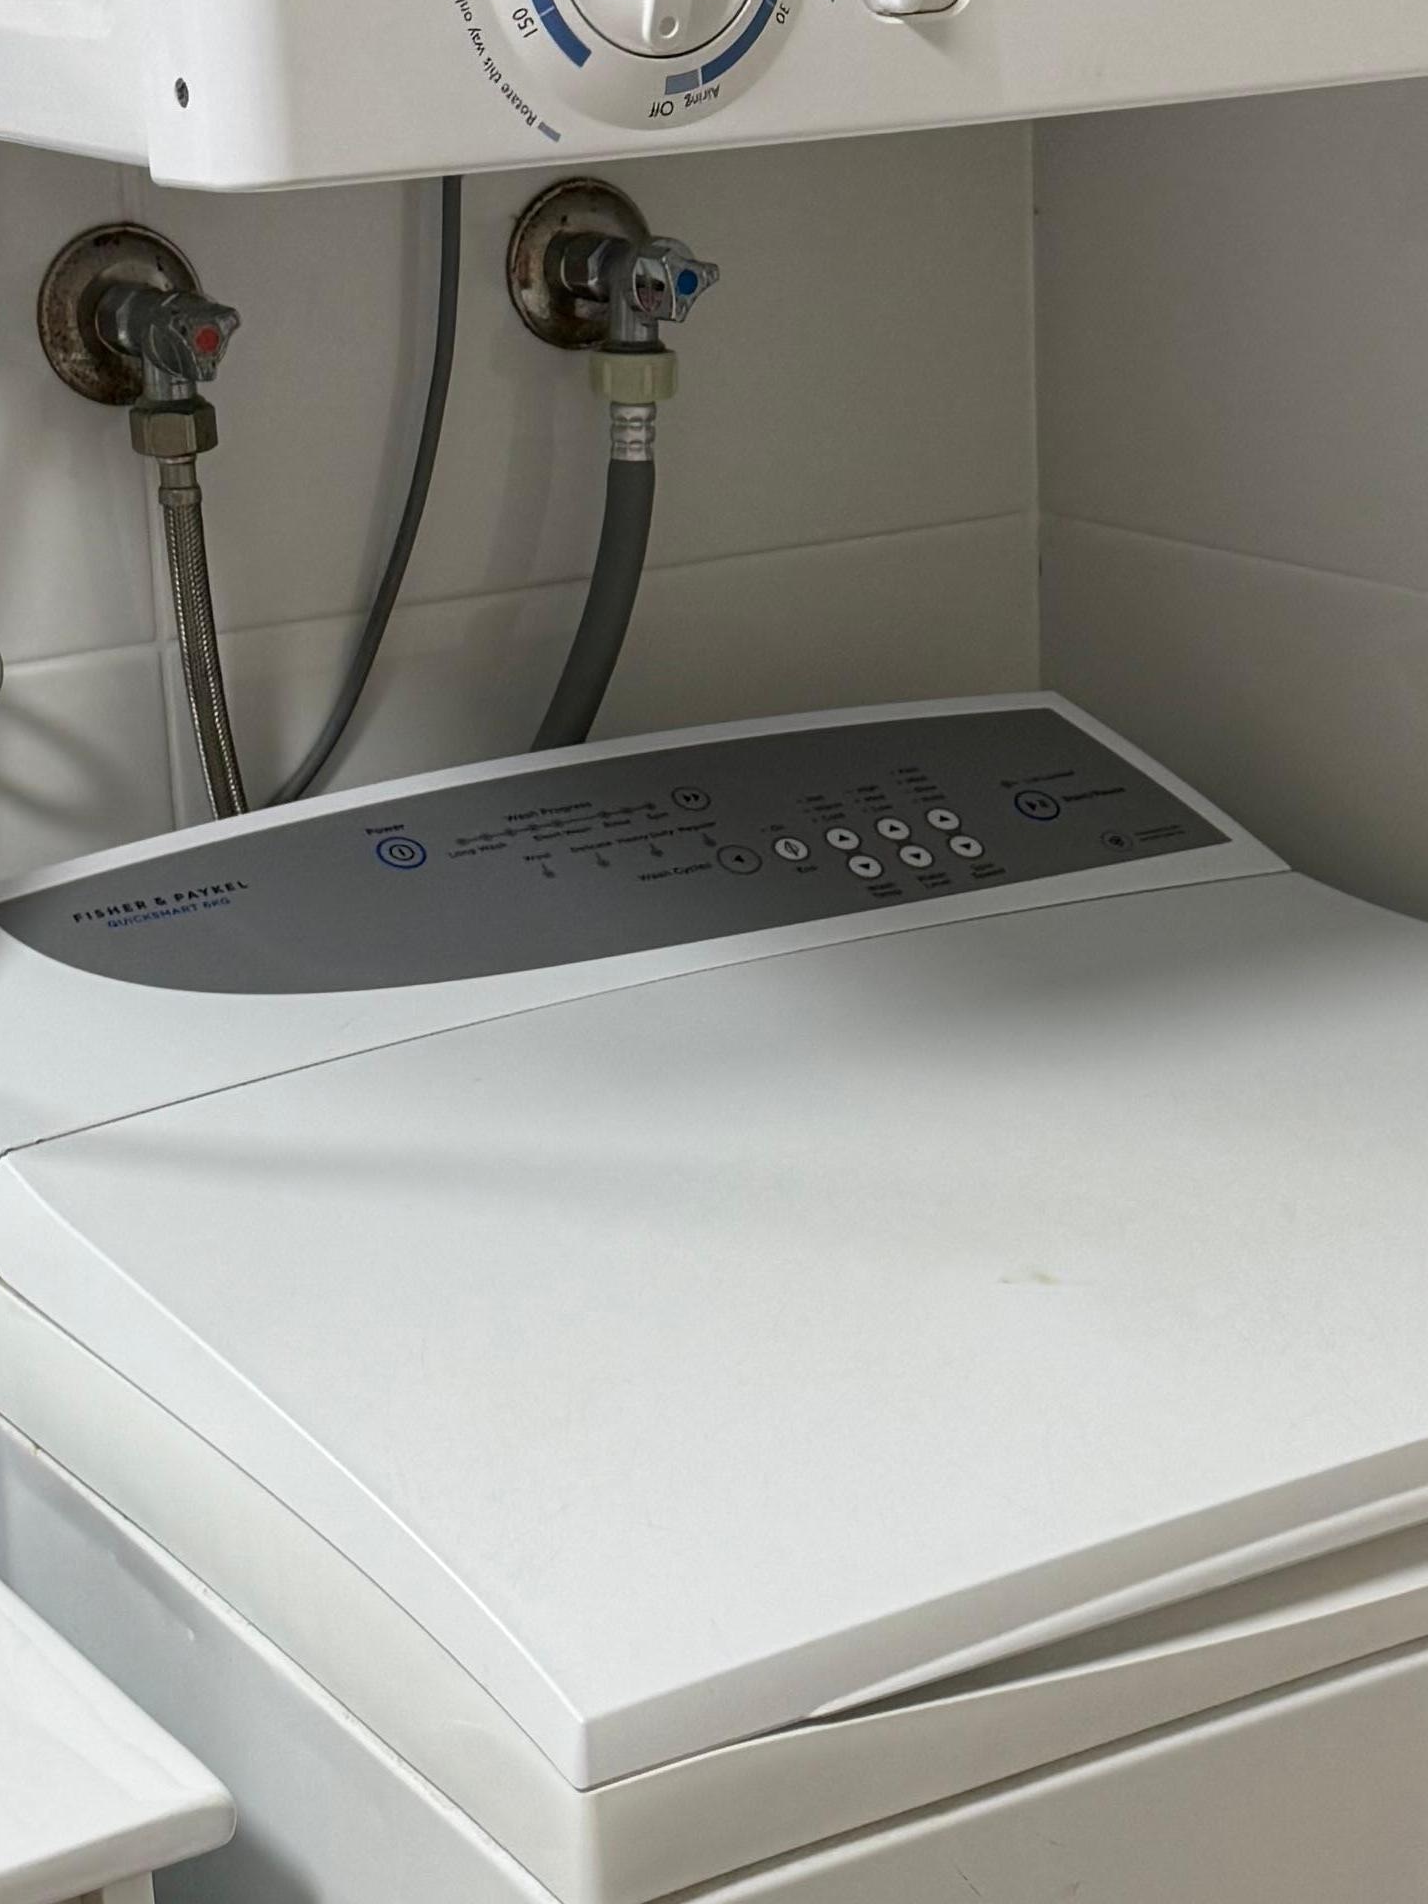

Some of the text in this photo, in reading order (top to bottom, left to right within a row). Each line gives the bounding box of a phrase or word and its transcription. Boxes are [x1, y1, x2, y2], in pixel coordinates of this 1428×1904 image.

[512, 7, 539, 38] 150
[775, 5, 791, 24] 30
[468, 27, 486, 57] way
[483, 56, 502, 82] this
[500, 81, 538, 128] Rotate
[683, 82, 720, 108] Airing
[648, 100, 674, 118] Off
[365, 823, 405, 835] Power
[72, 879, 249, 923] FISHER & PAYKEL
[107, 903, 198, 928] QUICKSMART
